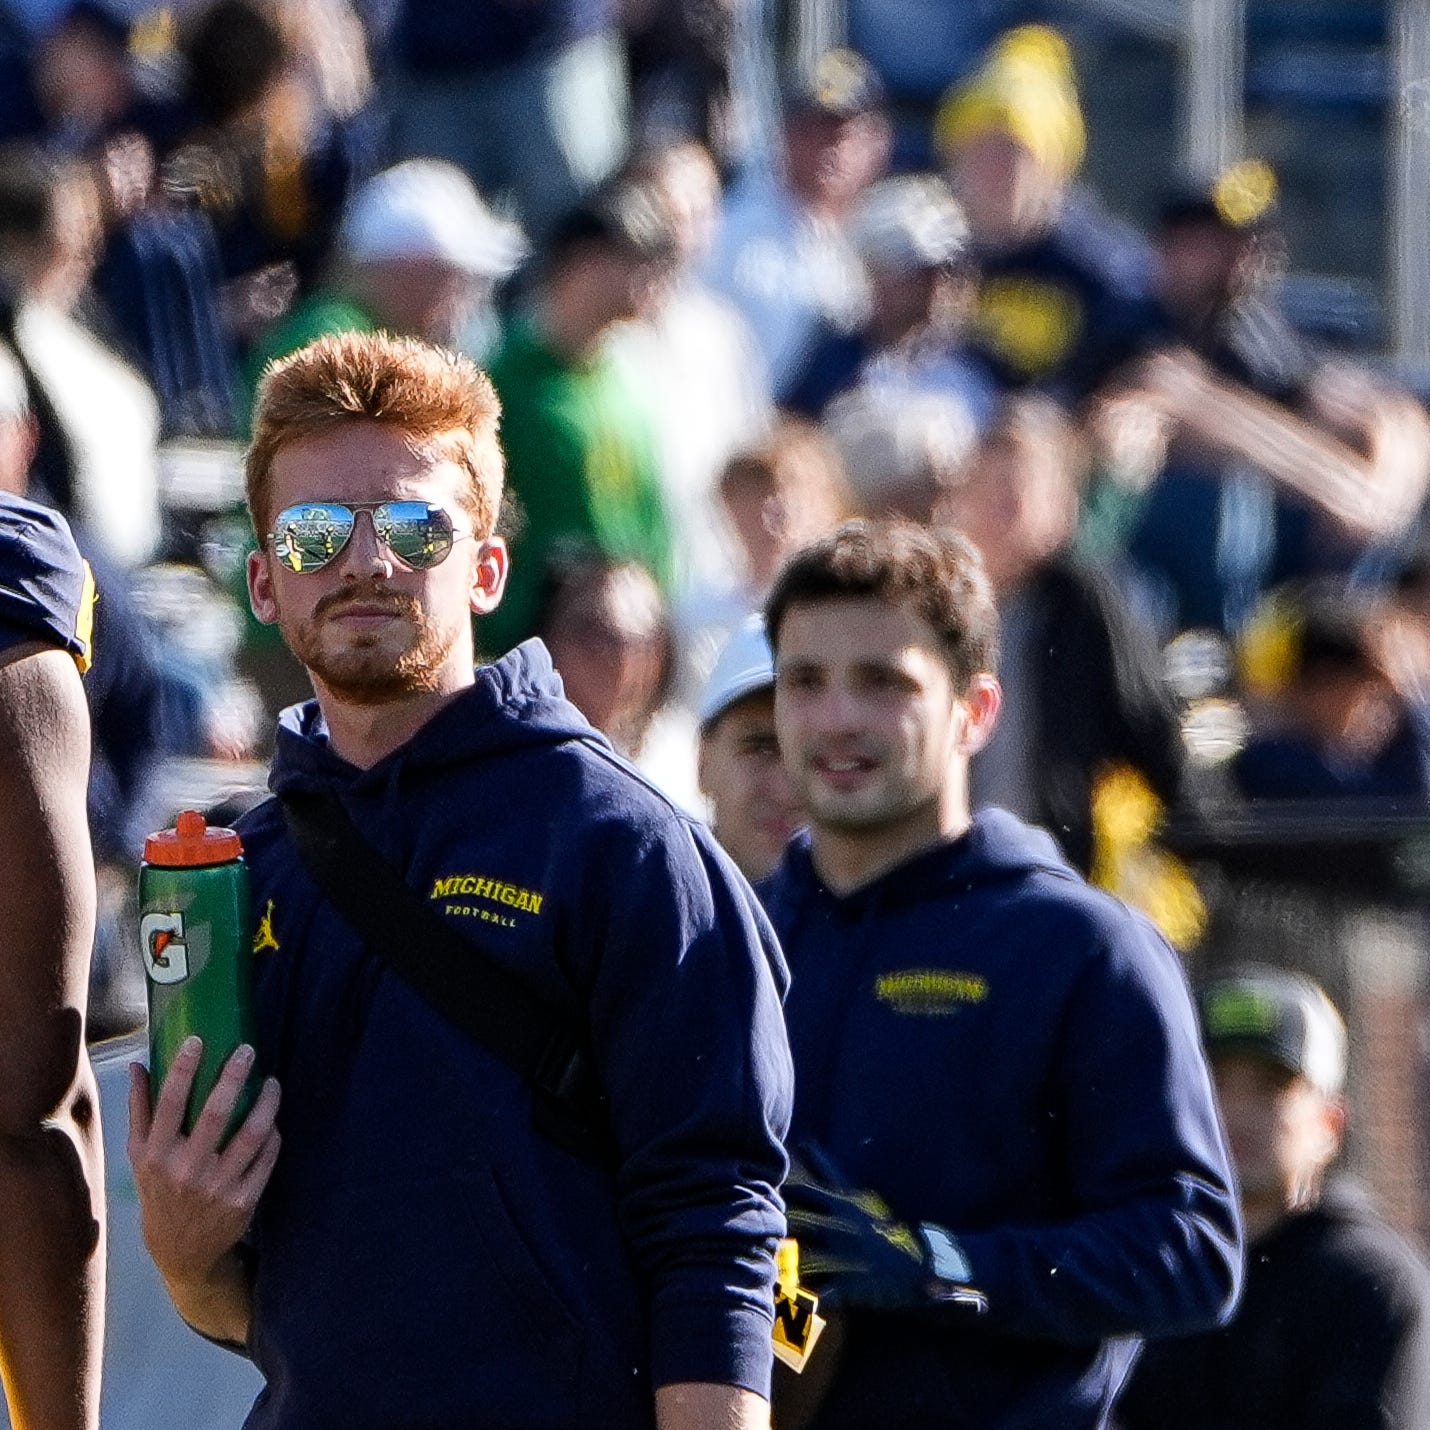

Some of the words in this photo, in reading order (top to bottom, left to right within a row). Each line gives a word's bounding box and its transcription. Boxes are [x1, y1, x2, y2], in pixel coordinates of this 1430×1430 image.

[430, 876, 543, 914] MICHIGAN
[445, 905, 517, 928] FOOTBALL
[140, 912, 189, 985] G
